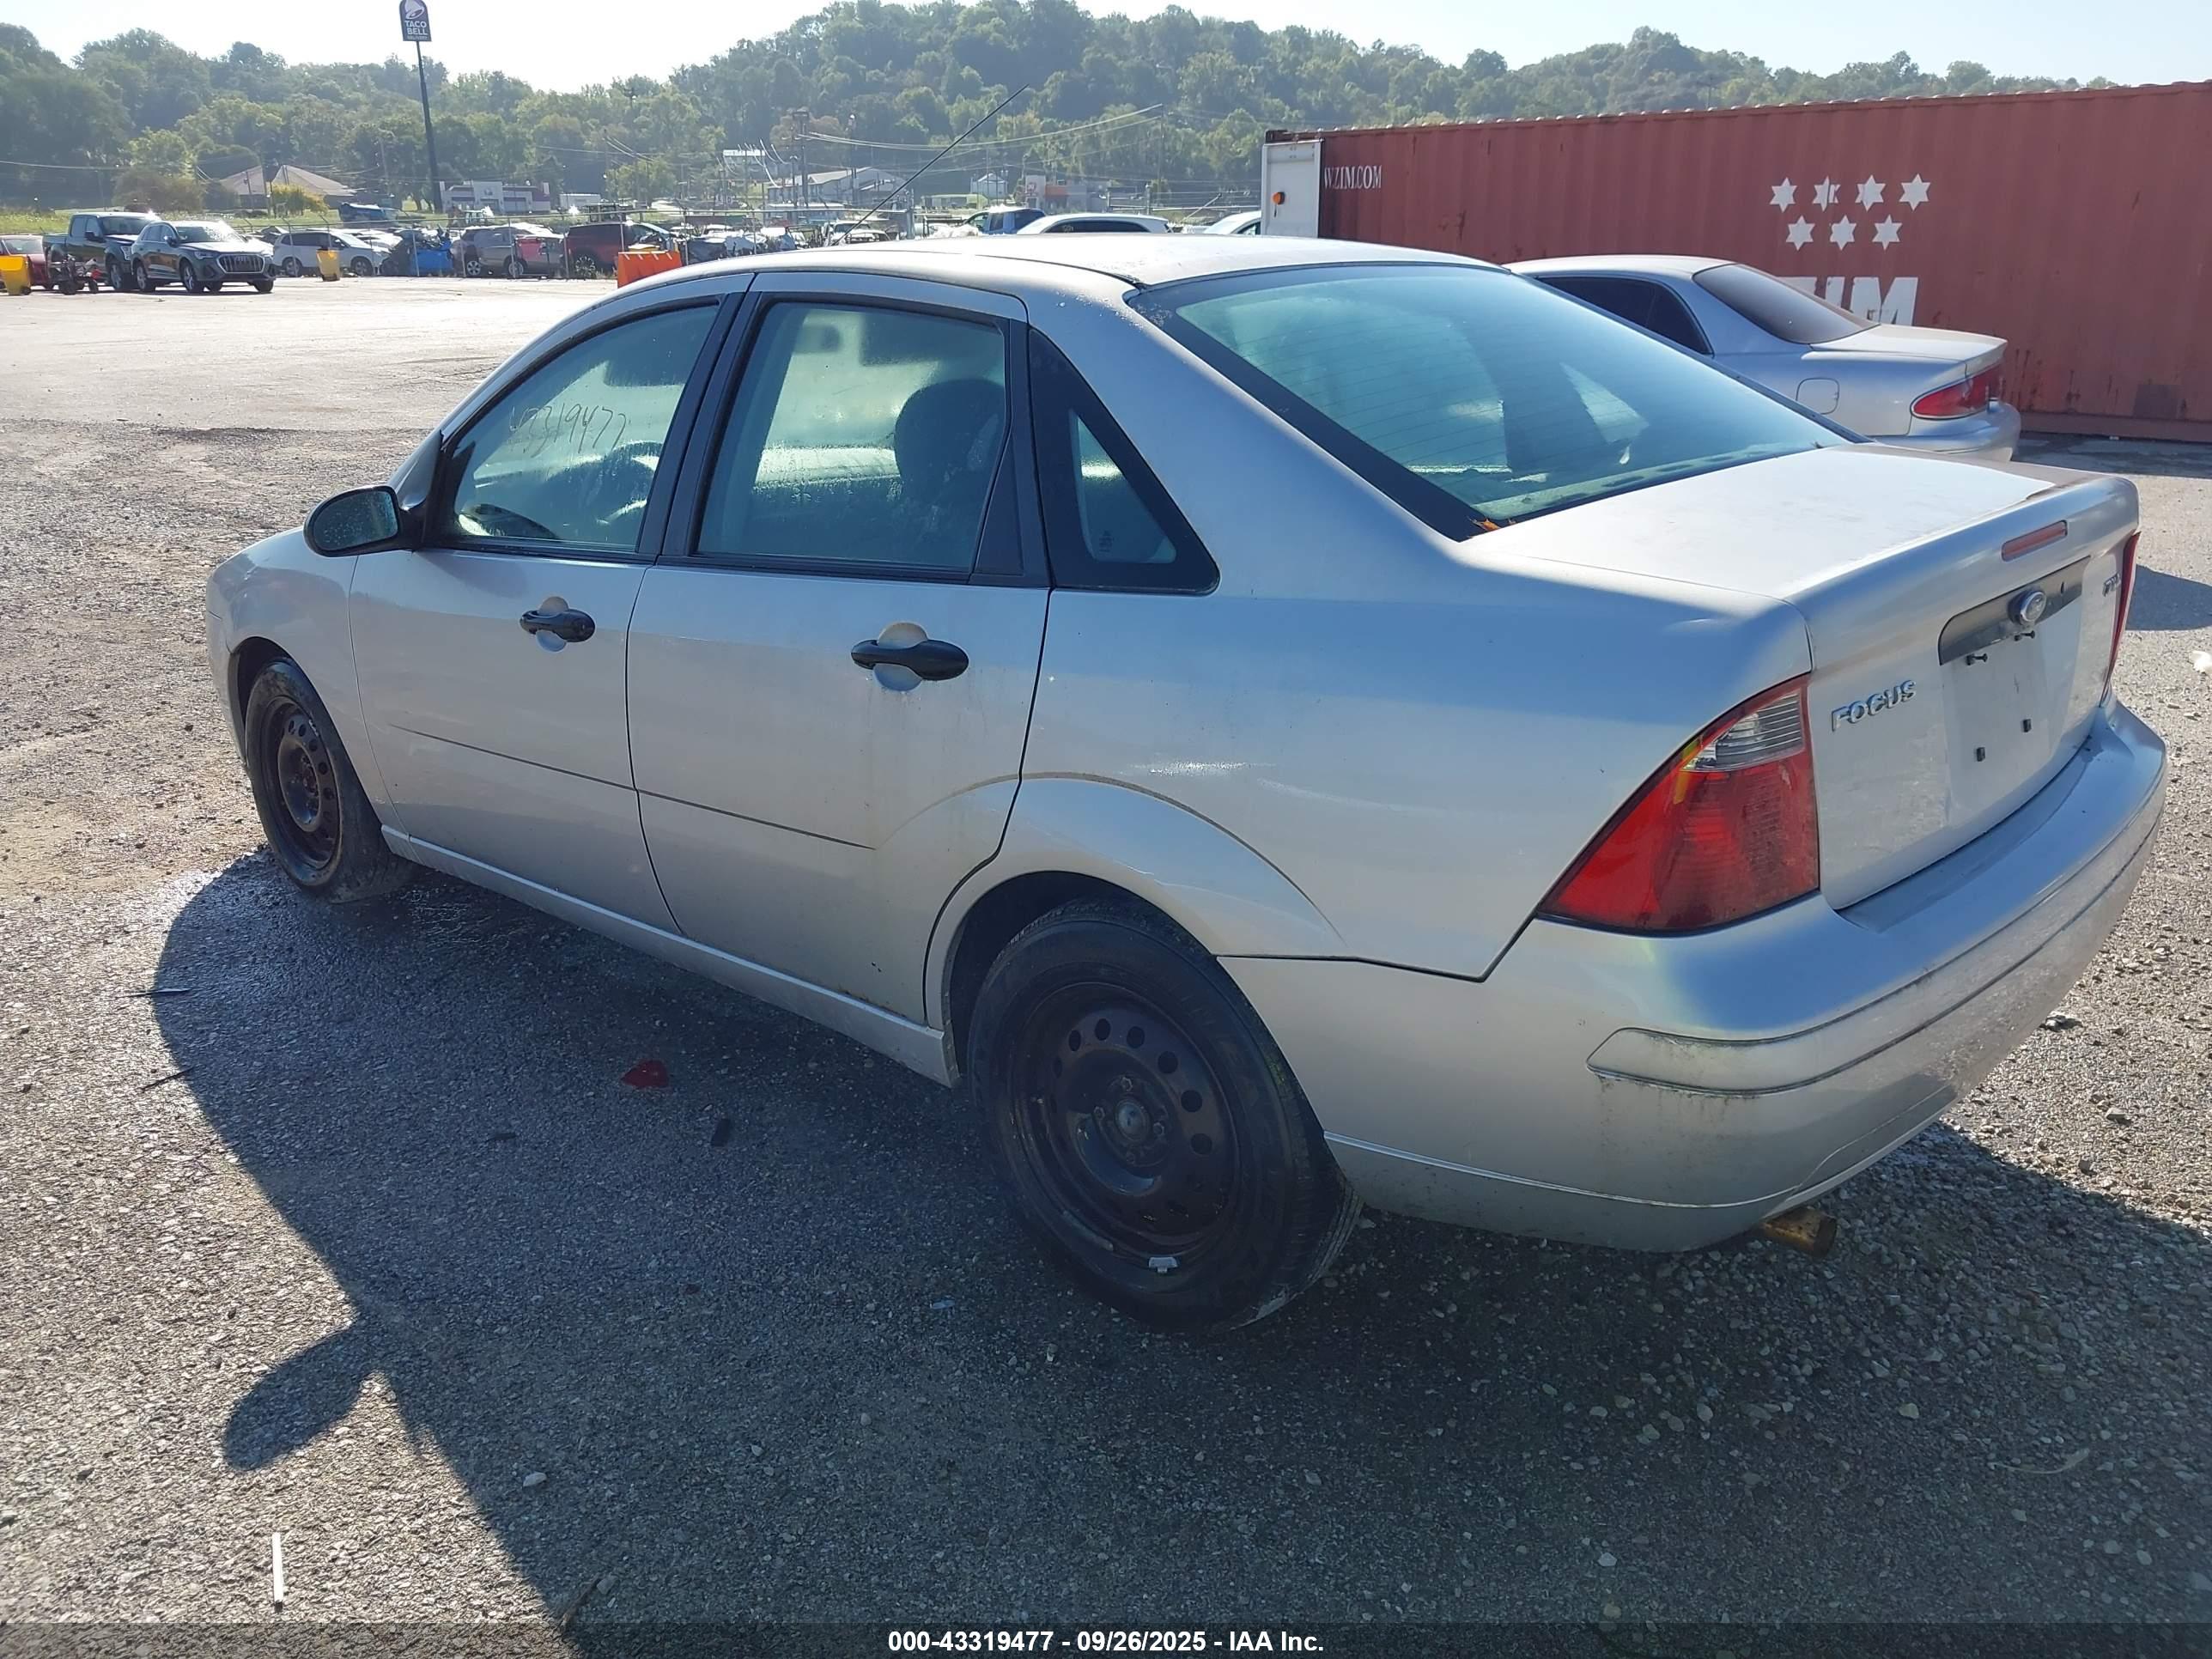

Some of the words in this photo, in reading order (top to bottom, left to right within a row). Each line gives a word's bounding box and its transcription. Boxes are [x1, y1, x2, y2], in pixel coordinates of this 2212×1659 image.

[404, 20, 427, 28] TACO
[406, 27, 428, 36] BELL
[1831, 679, 1917, 732] FOCUS
